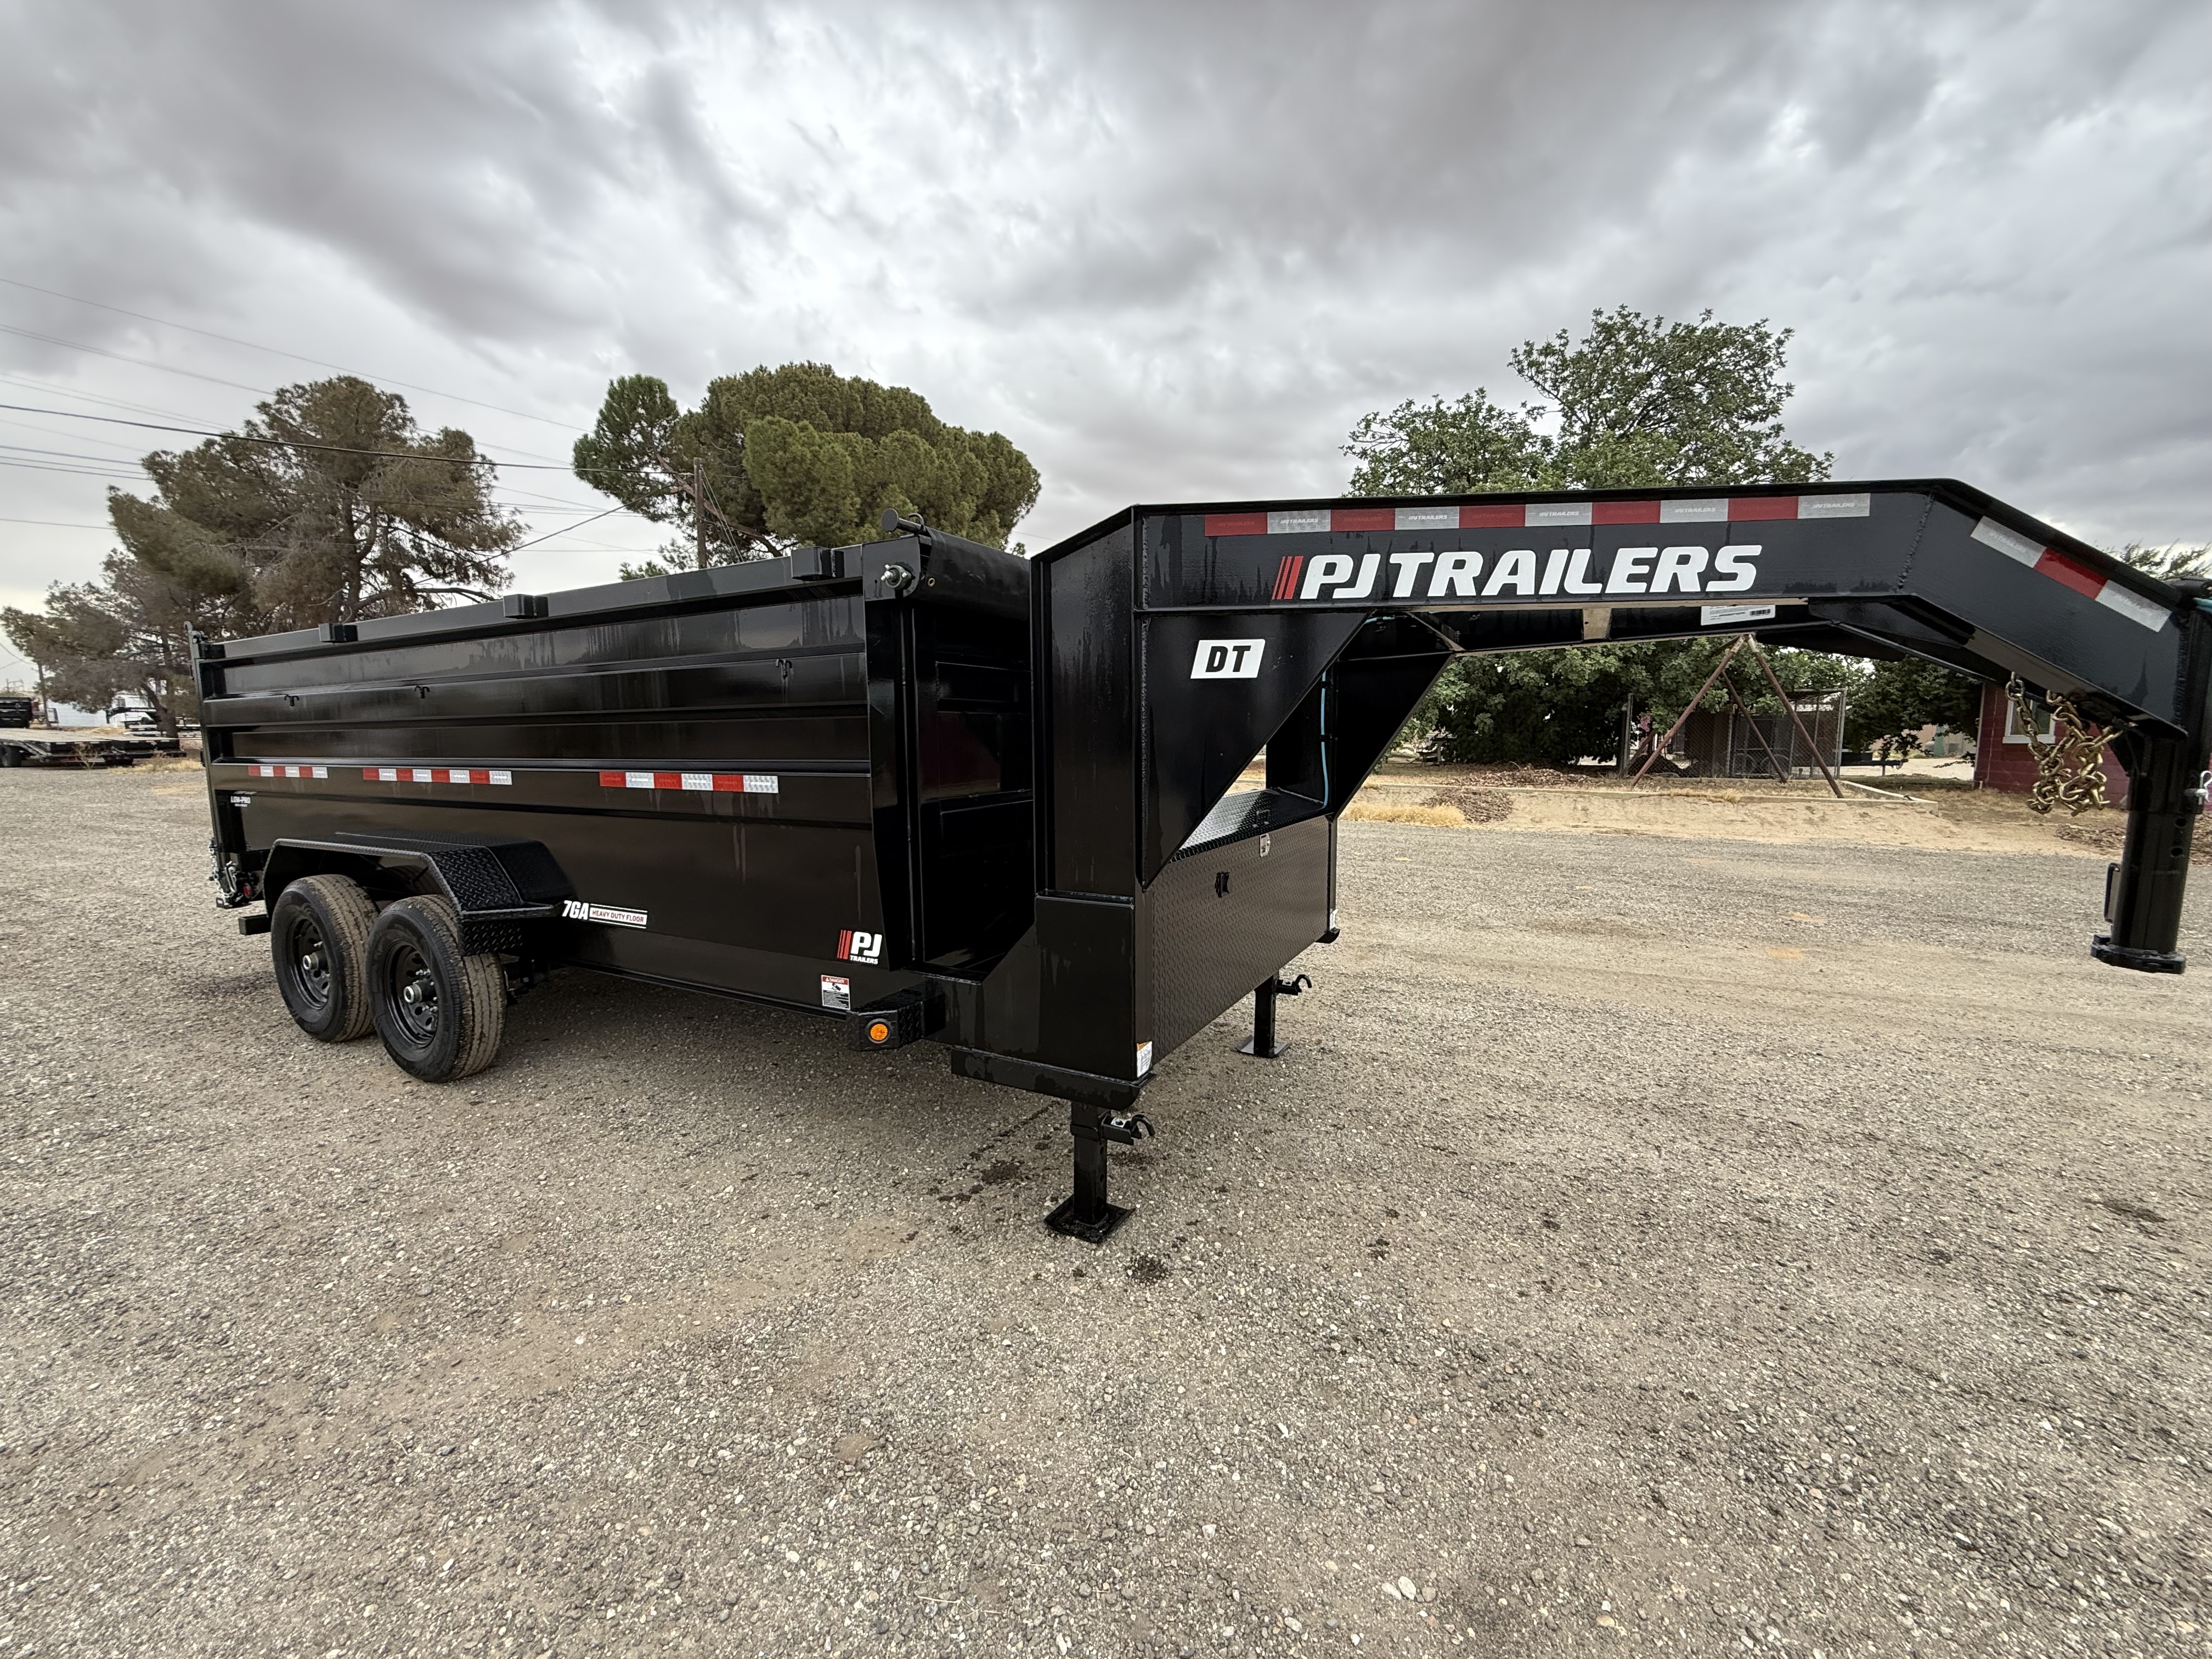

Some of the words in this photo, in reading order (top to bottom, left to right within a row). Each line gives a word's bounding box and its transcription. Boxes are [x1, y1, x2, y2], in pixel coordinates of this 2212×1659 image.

[1390, 545, 1763, 597] TRAILERS
[1205, 645, 1252, 673] DT
[562, 900, 589, 920] 7GA
[592, 910, 610, 918] HEAVY
[611, 912, 625, 920] DUTY
[626, 914, 644, 923] FLOOR
[850, 931, 882, 957] PJ
[850, 955, 878, 964] TRAILERS
